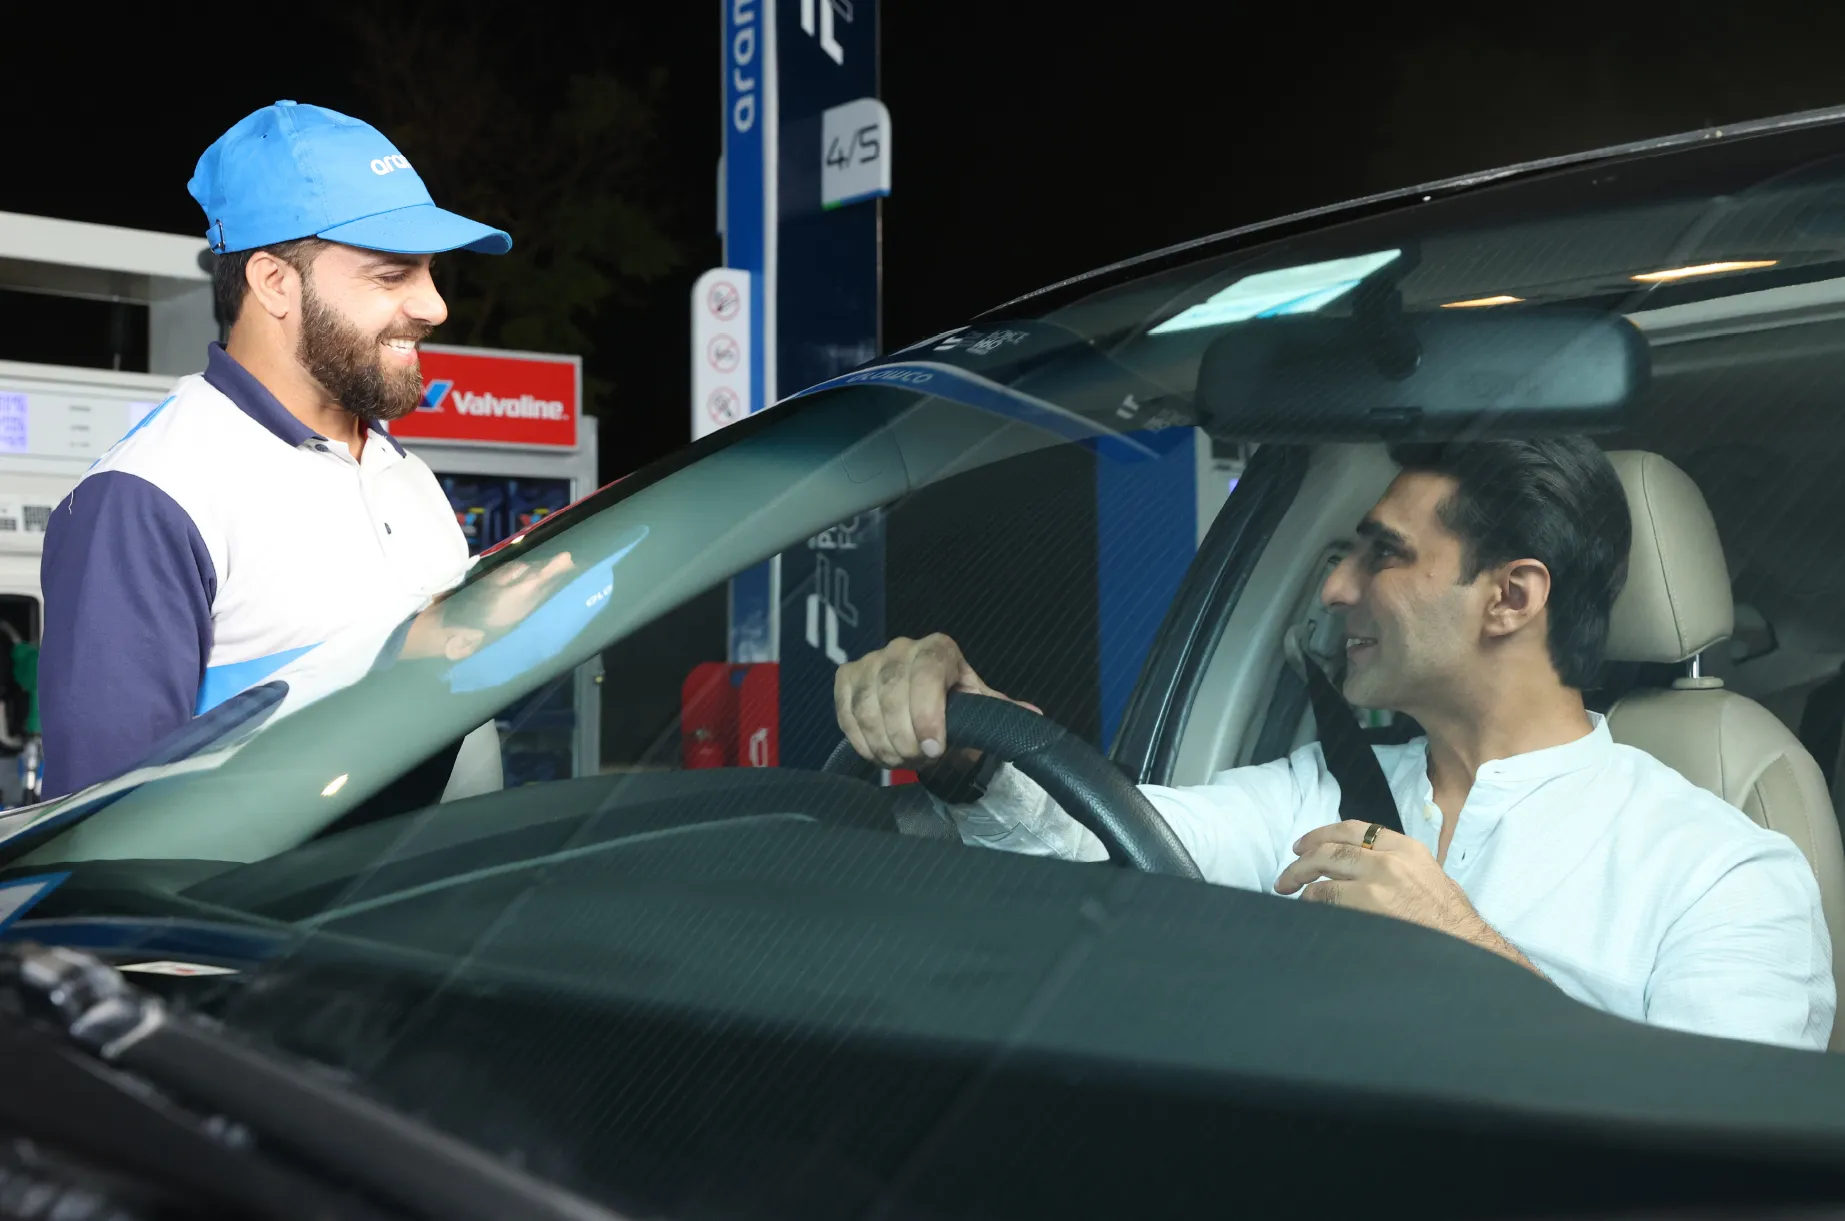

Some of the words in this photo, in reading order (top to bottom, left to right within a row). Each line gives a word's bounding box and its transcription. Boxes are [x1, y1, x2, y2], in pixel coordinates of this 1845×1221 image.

[826, 123, 881, 170] 4/5
[370, 154, 413, 176] ara
[451, 390, 564, 421] Valvoline
